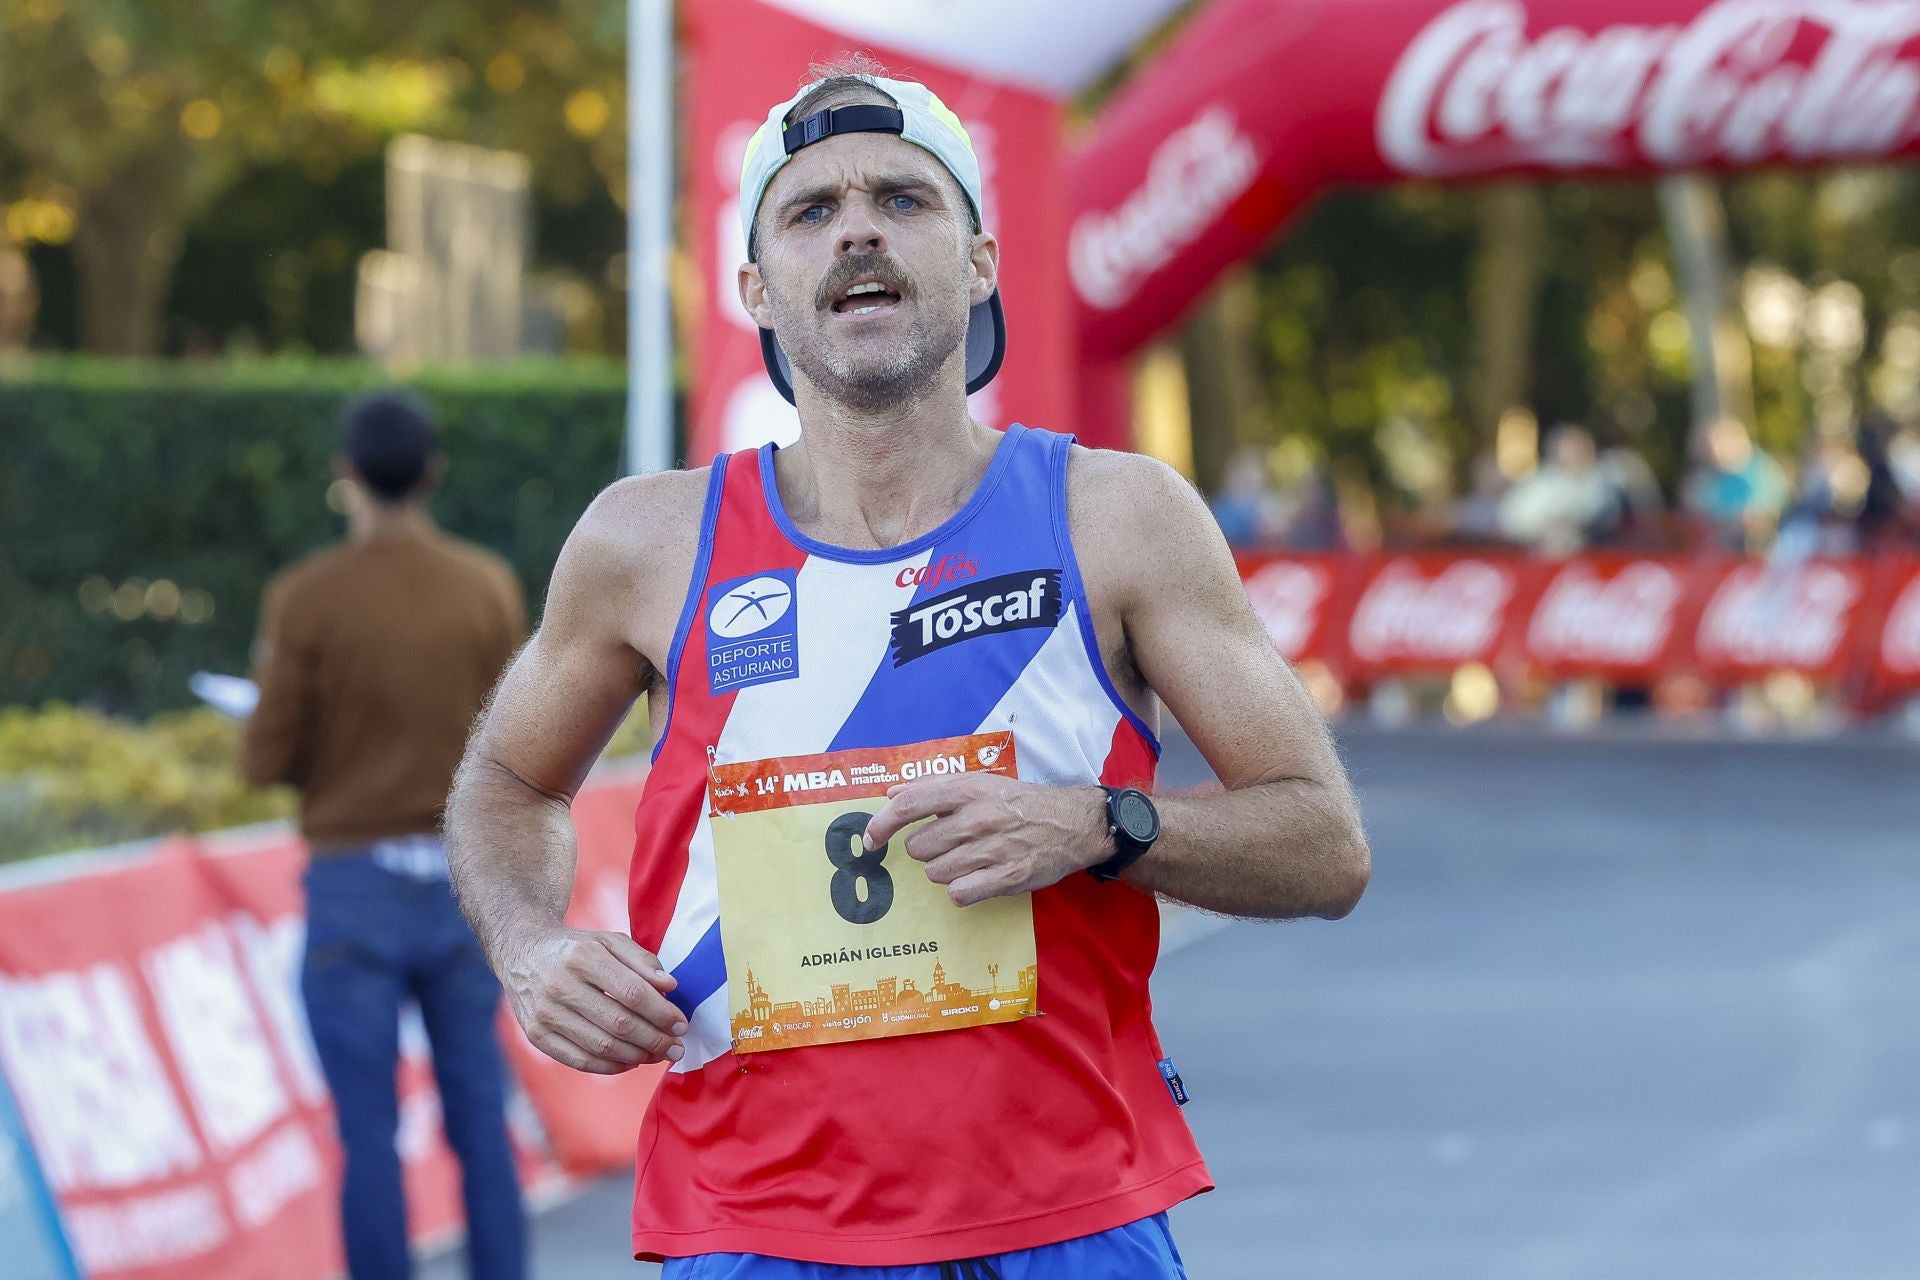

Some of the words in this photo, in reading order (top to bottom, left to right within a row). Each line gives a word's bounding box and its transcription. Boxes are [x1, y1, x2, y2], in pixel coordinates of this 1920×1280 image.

[895, 552, 980, 592] cafés
[908, 577, 1047, 647] Toscaf
[711, 640, 792, 667] DEPORTE
[713, 656, 793, 685] ASTURIANO
[850, 763, 887, 776] media
[851, 772, 900, 786] maratón
[900, 753, 966, 781] GIJÓN
[783, 769, 848, 793] MBA
[825, 811, 894, 925] 8
[800, 947, 863, 968] ADRIÁN
[865, 941, 939, 960] IGLESIAS
[842, 1014, 872, 1028] gijón
[941, 1005, 980, 1017] SIROKO
[1164, 1063, 1174, 1078] DRY
[1170, 1078, 1184, 1101] QUICK
